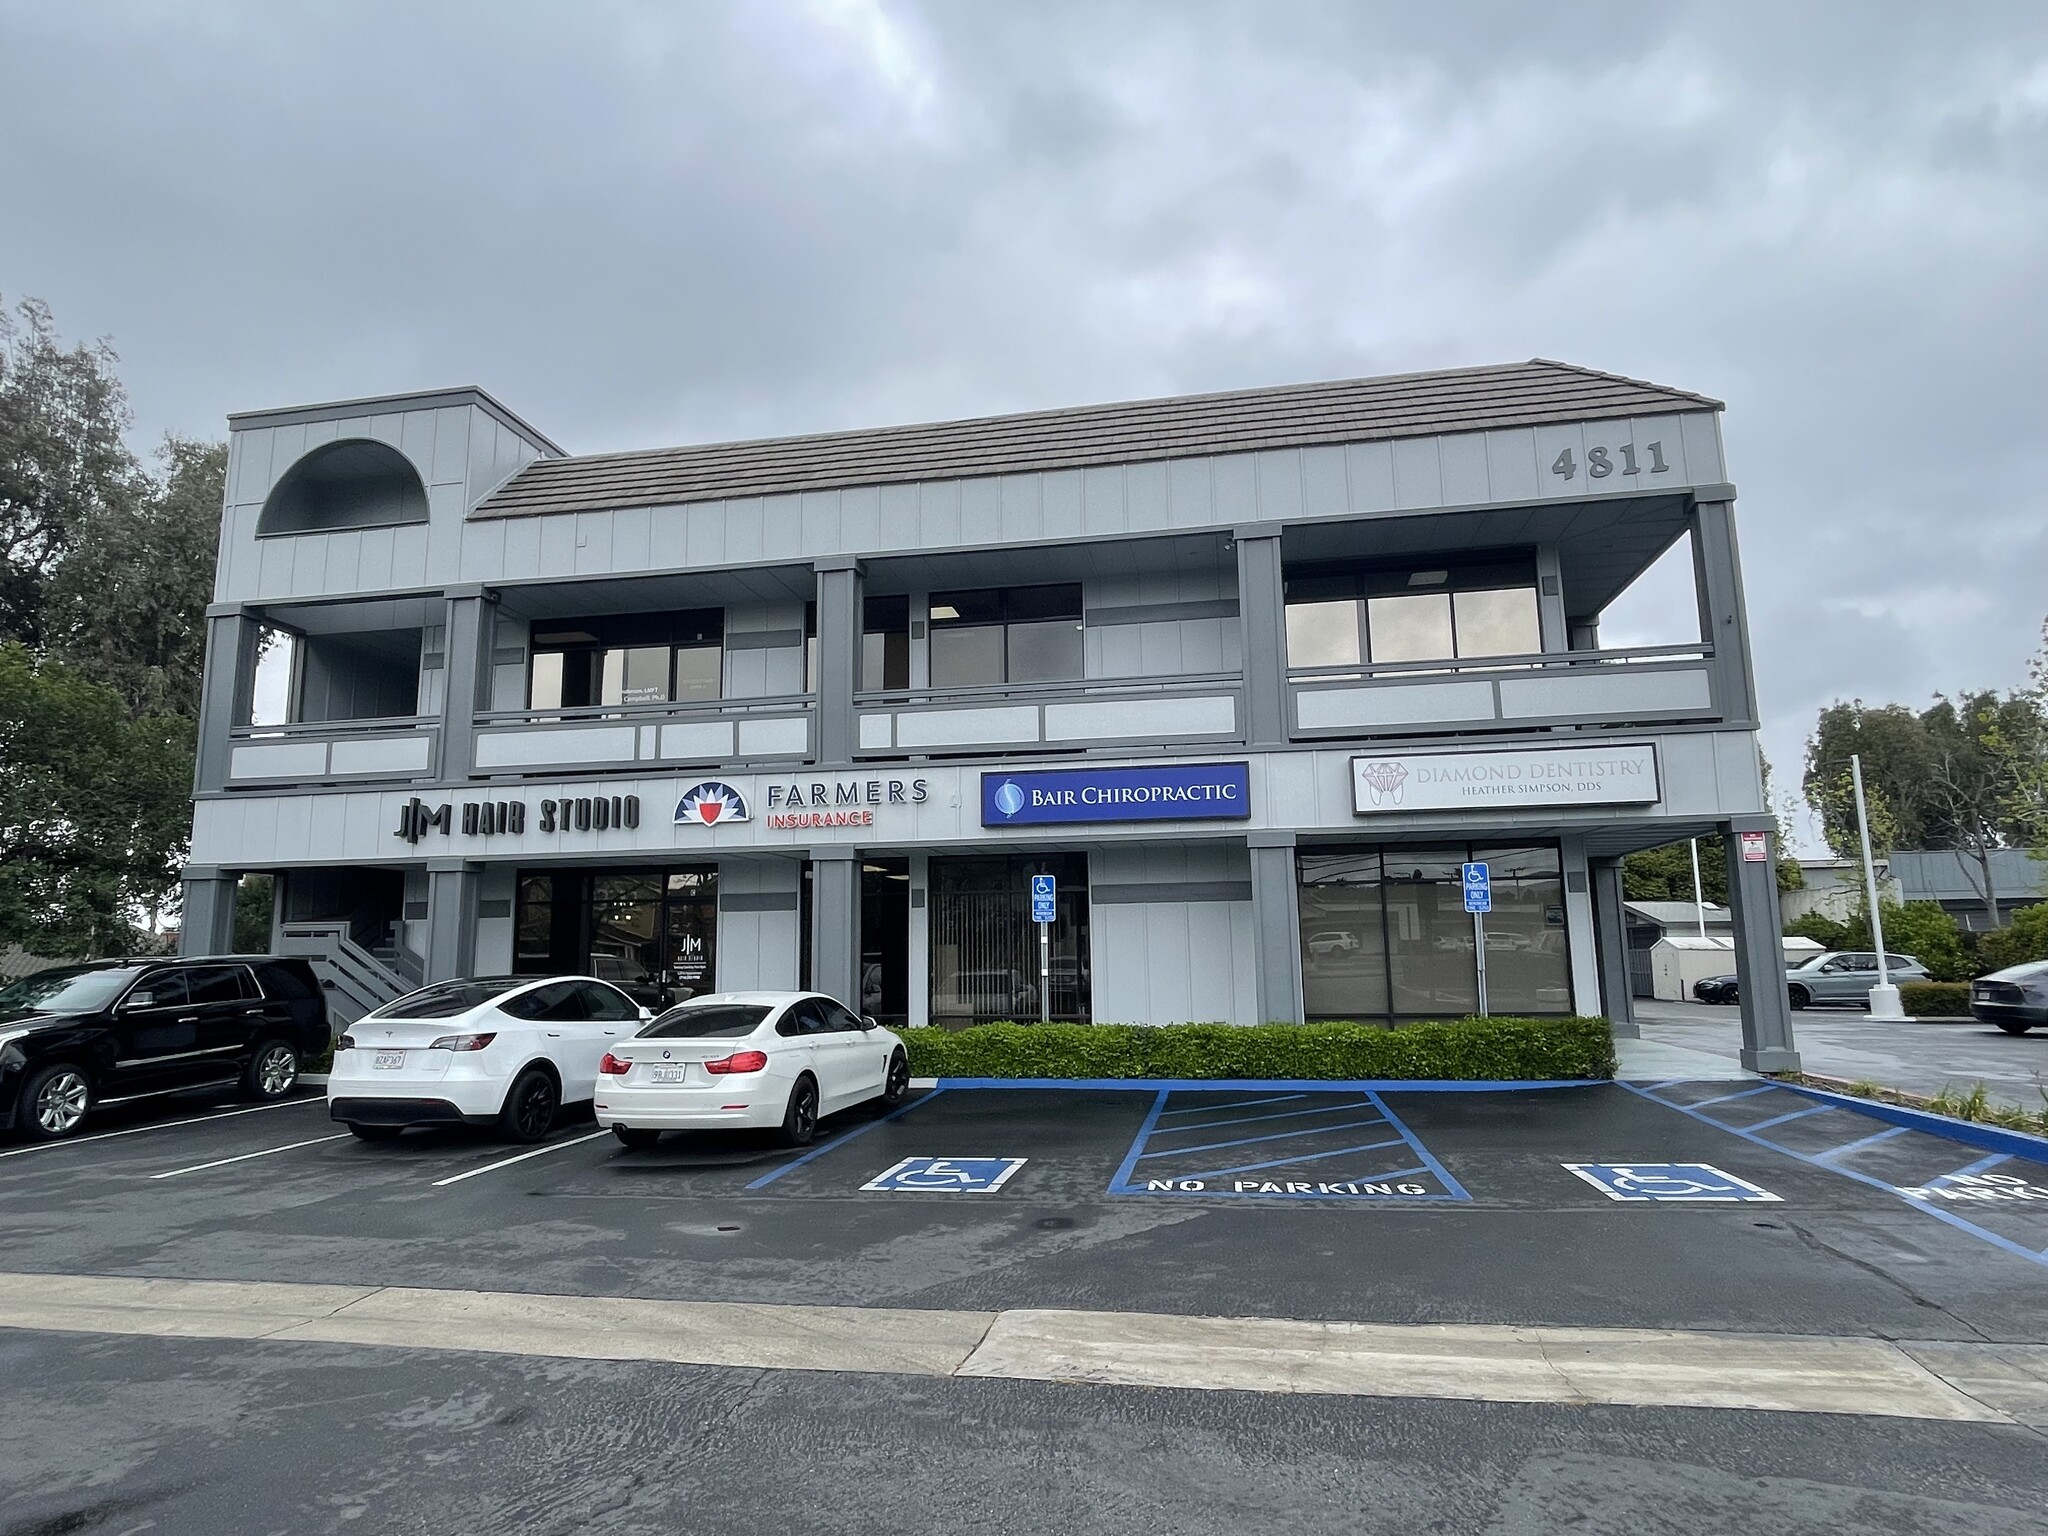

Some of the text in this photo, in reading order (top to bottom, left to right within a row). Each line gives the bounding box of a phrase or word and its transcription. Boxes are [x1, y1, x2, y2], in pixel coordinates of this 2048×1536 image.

[1551, 440, 1670, 481] 4811
[1416, 759, 1645, 783] DIAMOND DENTISTRY
[767, 778, 929, 808] FARMERS
[1081, 783, 1238, 805] CHIROPRACTIC
[1462, 782, 1602, 796] HEATHER SIMPSON, DDS
[461, 800, 526, 836] HAIR
[539, 794, 640, 833] STUDIO
[766, 810, 873, 829] INSURANCE
[1465, 882, 1488, 891] PARKING
[1470, 891, 1484, 899] ONLY
[1034, 893, 1054, 902] PARKING
[1148, 1179, 1426, 1195] NO PARKING
[1939, 1174, 2029, 1186] NO
